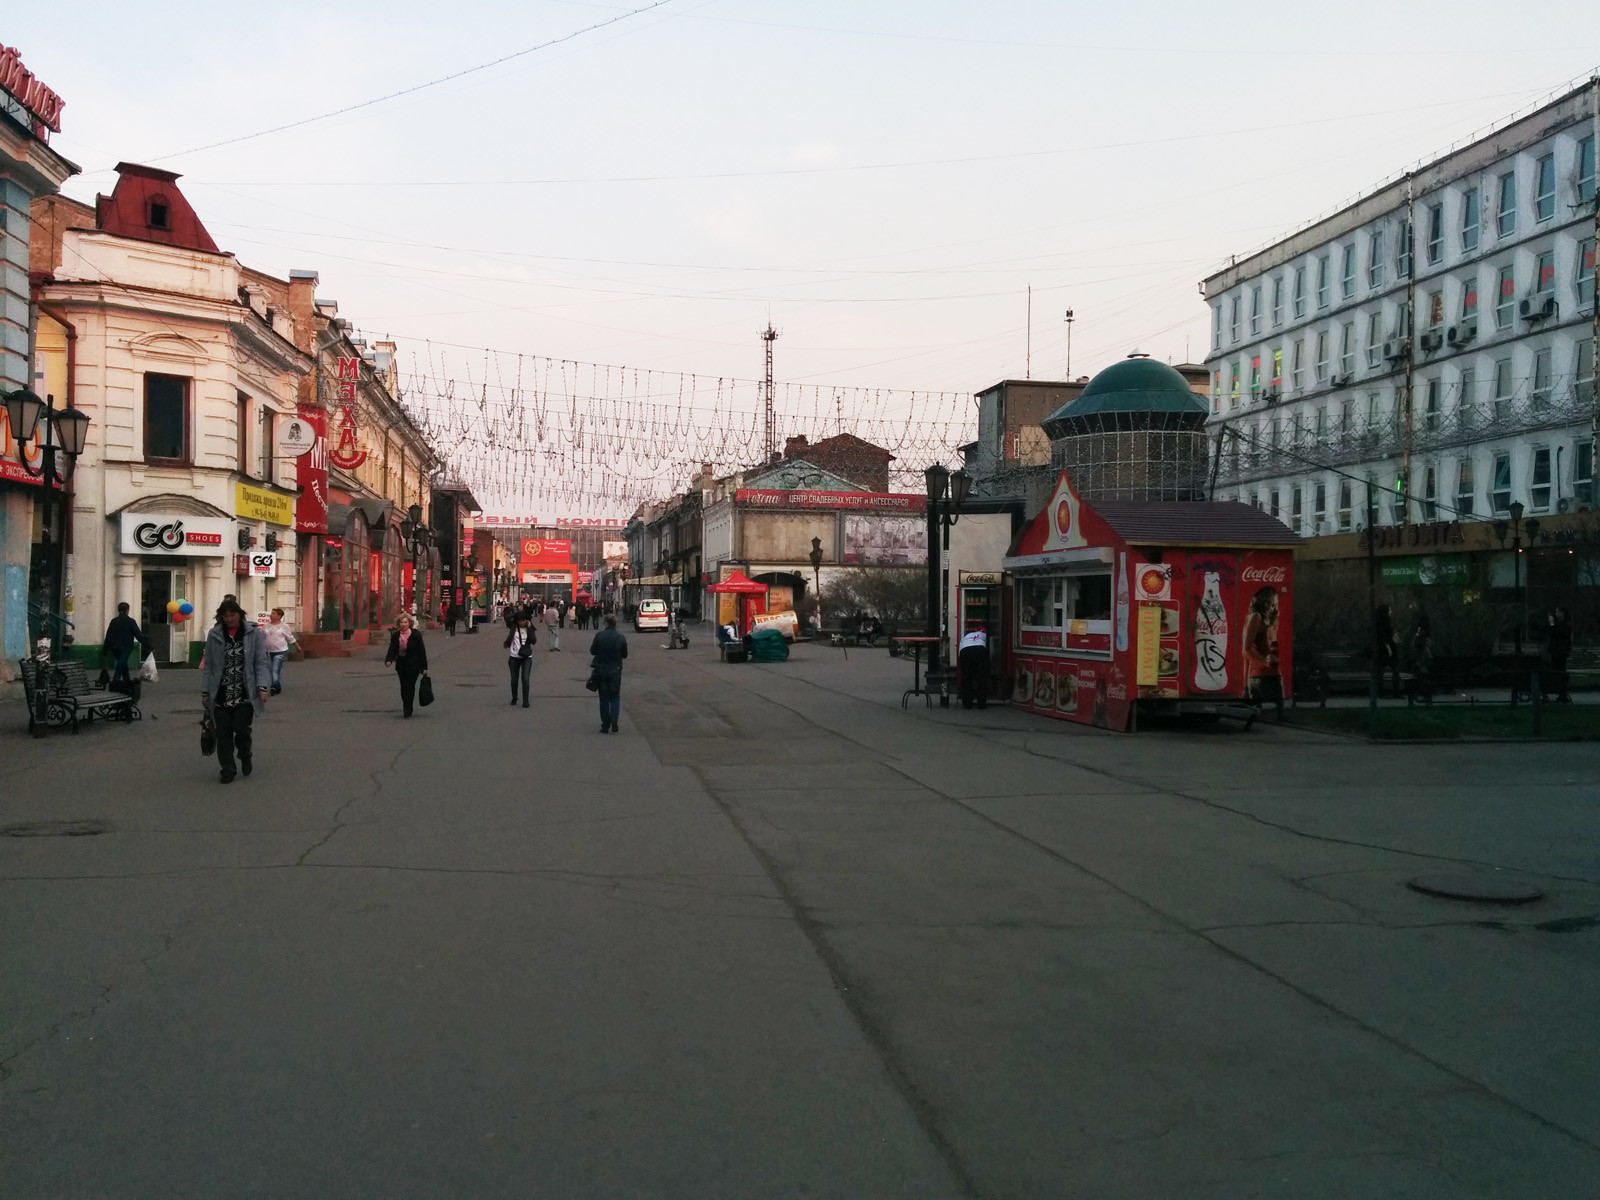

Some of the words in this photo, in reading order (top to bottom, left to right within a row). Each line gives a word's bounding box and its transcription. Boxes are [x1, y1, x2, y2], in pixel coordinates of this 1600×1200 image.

[789, 495, 808, 504] ЦЕНТР
[809, 495, 844, 504] СВАДЕБНЫХ
[845, 496, 863, 505] УСЛУГ
[189, 534, 220, 543] SHOES
[1242, 566, 1287, 582] Coca-Cola
